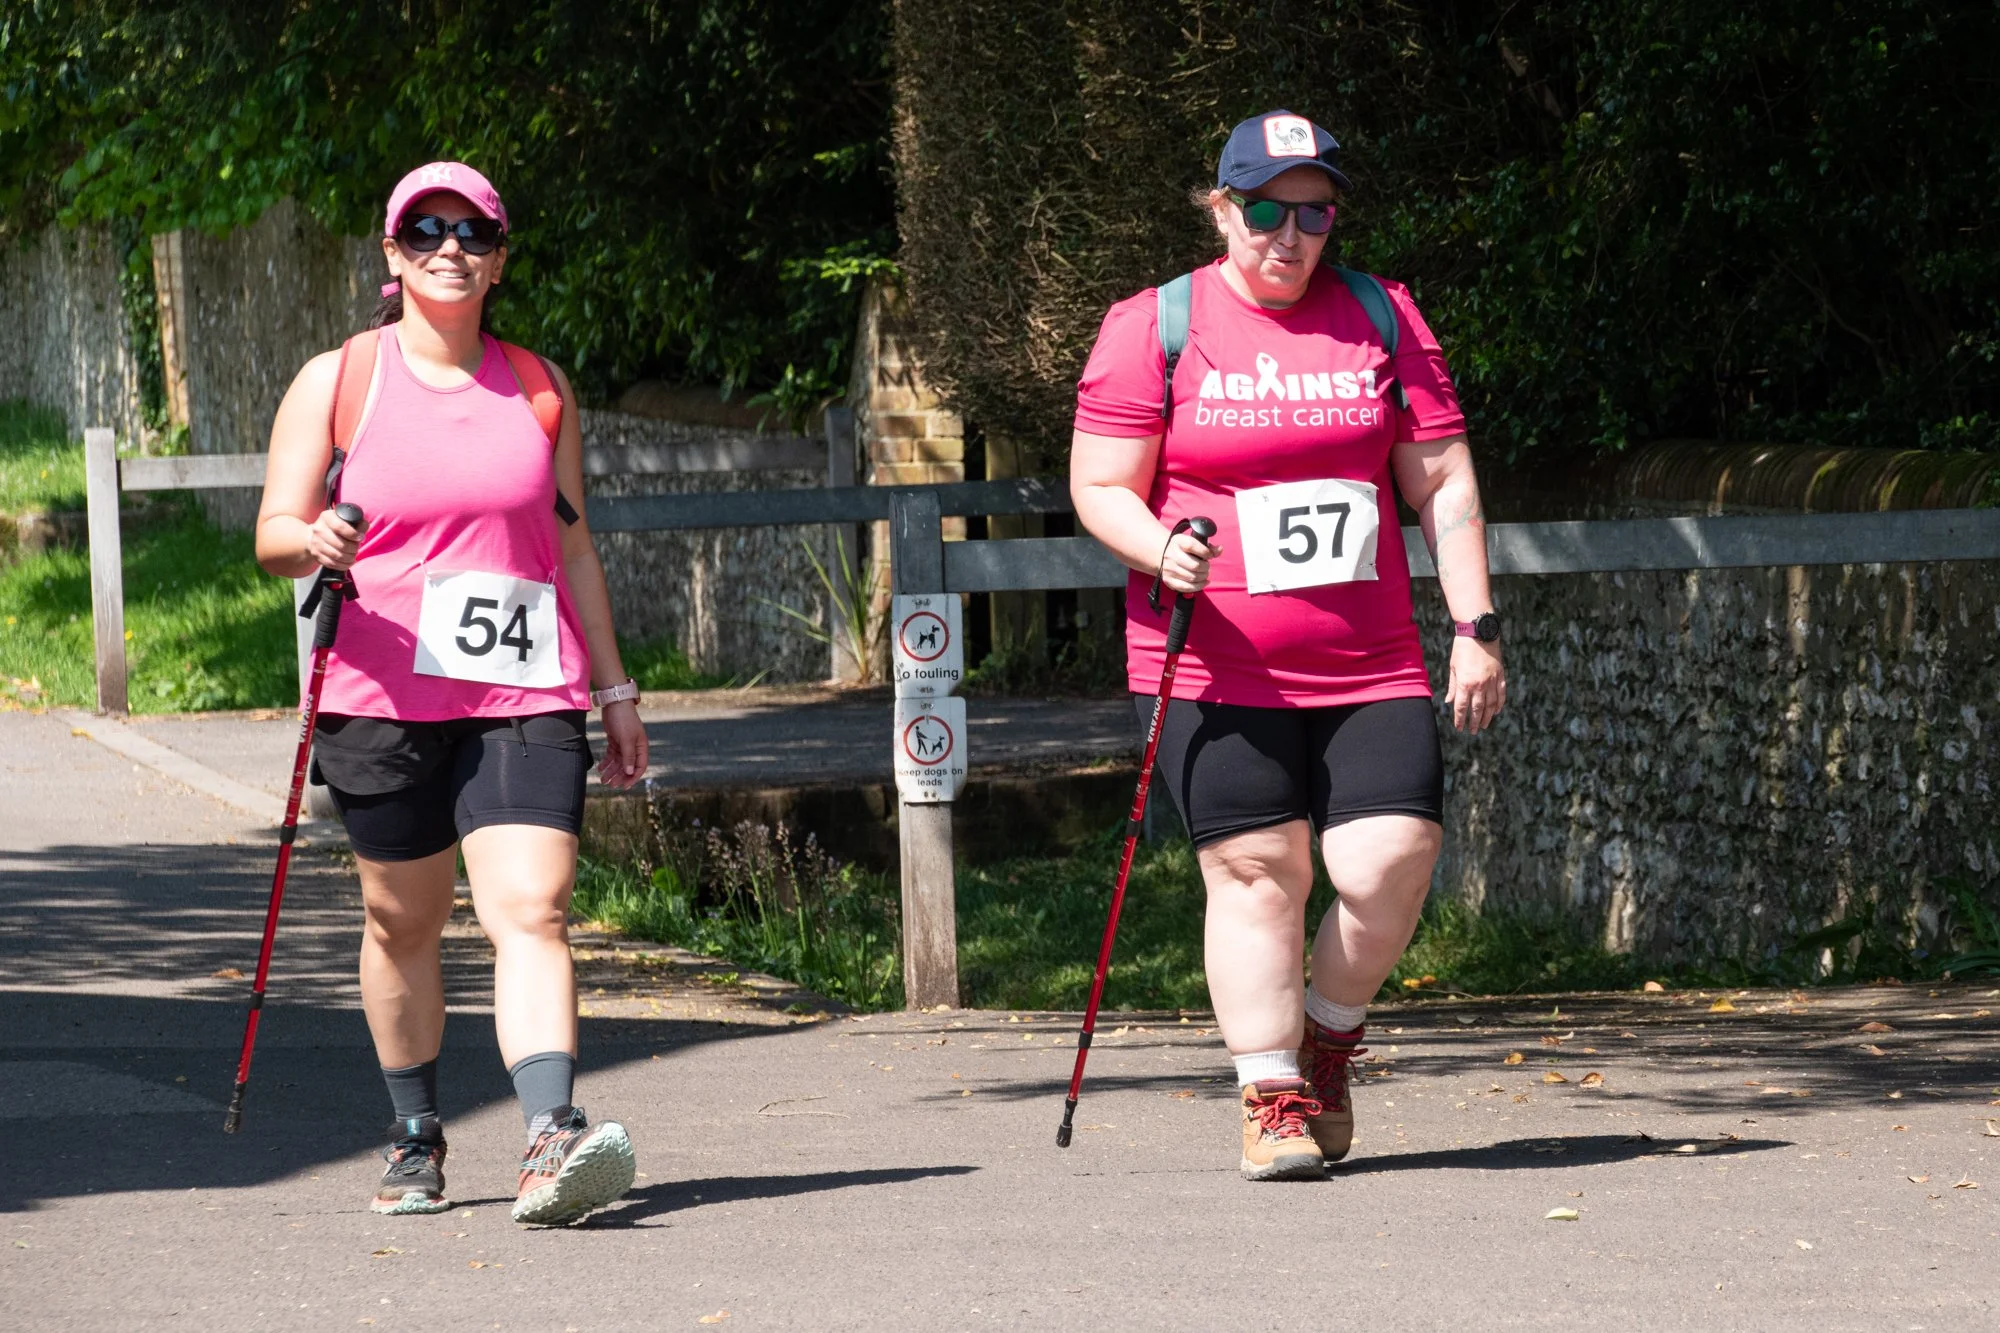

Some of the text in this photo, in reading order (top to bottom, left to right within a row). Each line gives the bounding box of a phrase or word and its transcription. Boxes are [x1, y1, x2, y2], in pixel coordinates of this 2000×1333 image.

[1195, 400, 1380, 427] breast cancer
[1278, 502, 1351, 564] 57
[455, 596, 533, 662] 54
[915, 667, 959, 681] fouling
[917, 778, 943, 786] leads
[924, 767, 948, 777] dogs
